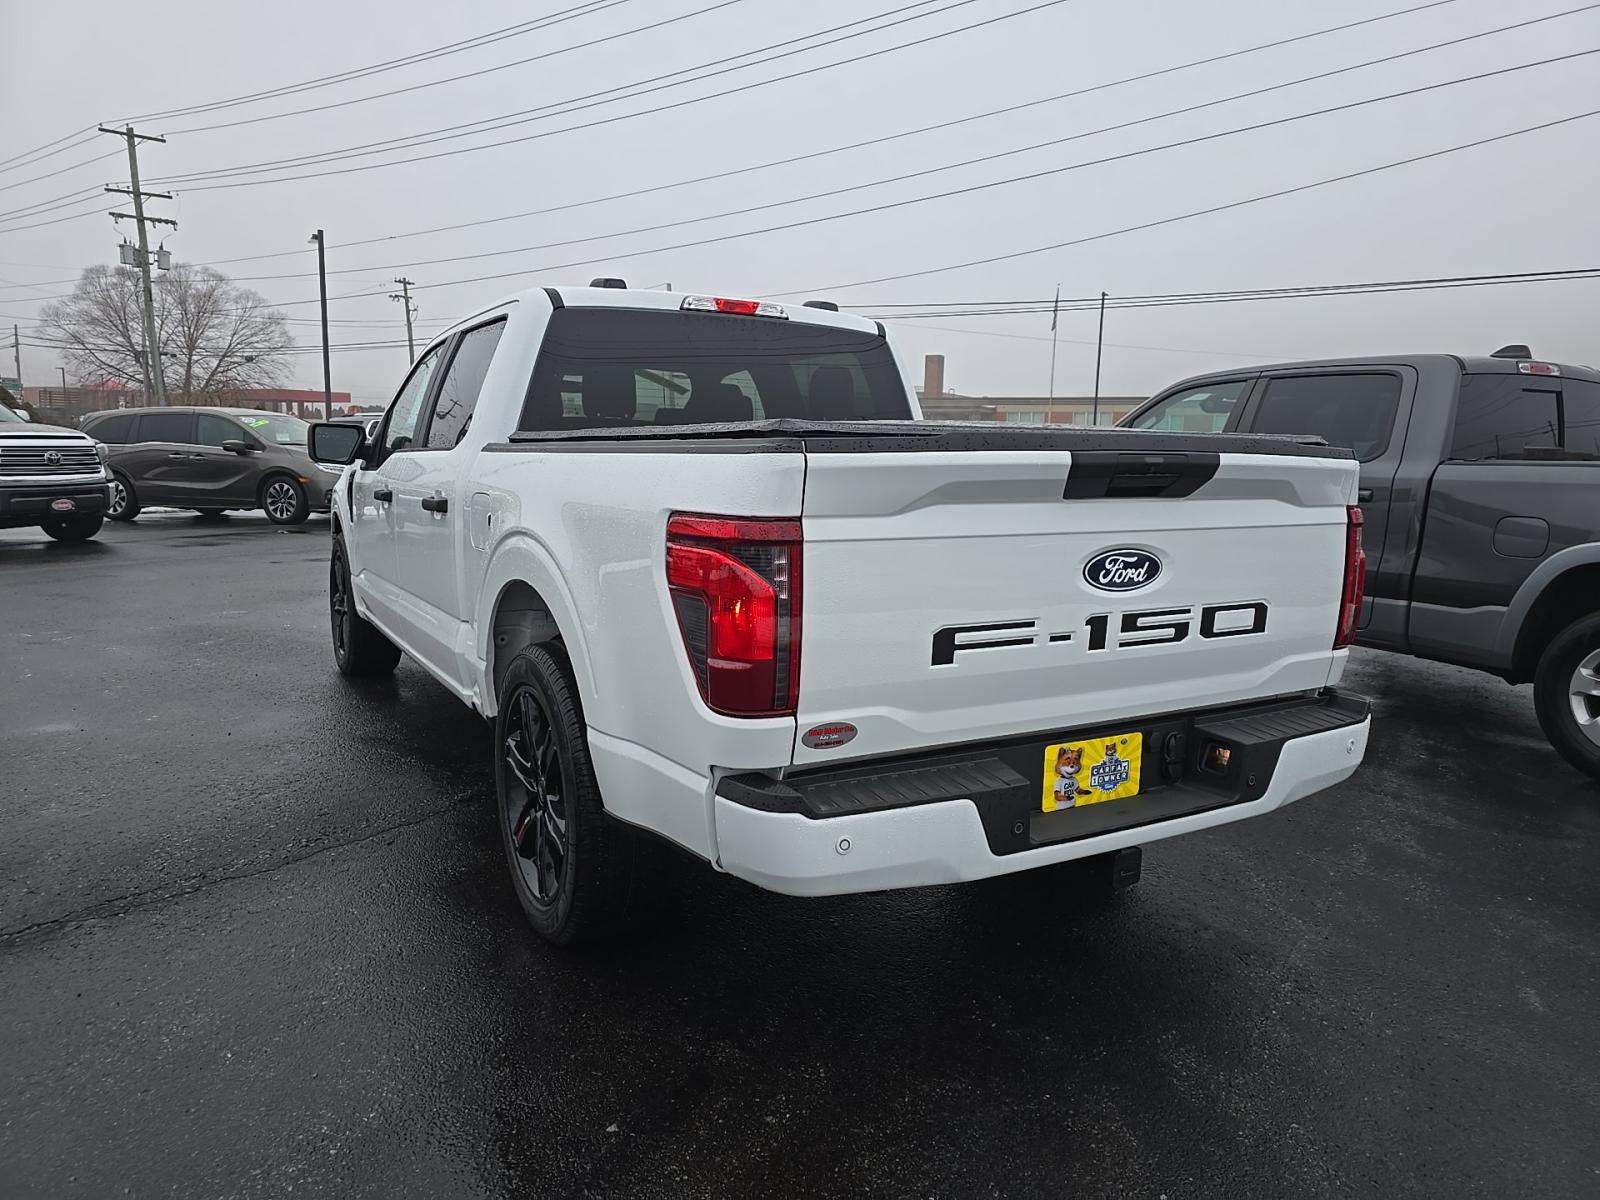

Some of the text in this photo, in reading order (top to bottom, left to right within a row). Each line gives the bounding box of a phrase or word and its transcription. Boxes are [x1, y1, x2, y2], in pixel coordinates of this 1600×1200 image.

[1099, 556, 1150, 584] Ford
[931, 601, 1270, 667] F-150
[1093, 762, 1128, 775] CARFAX
